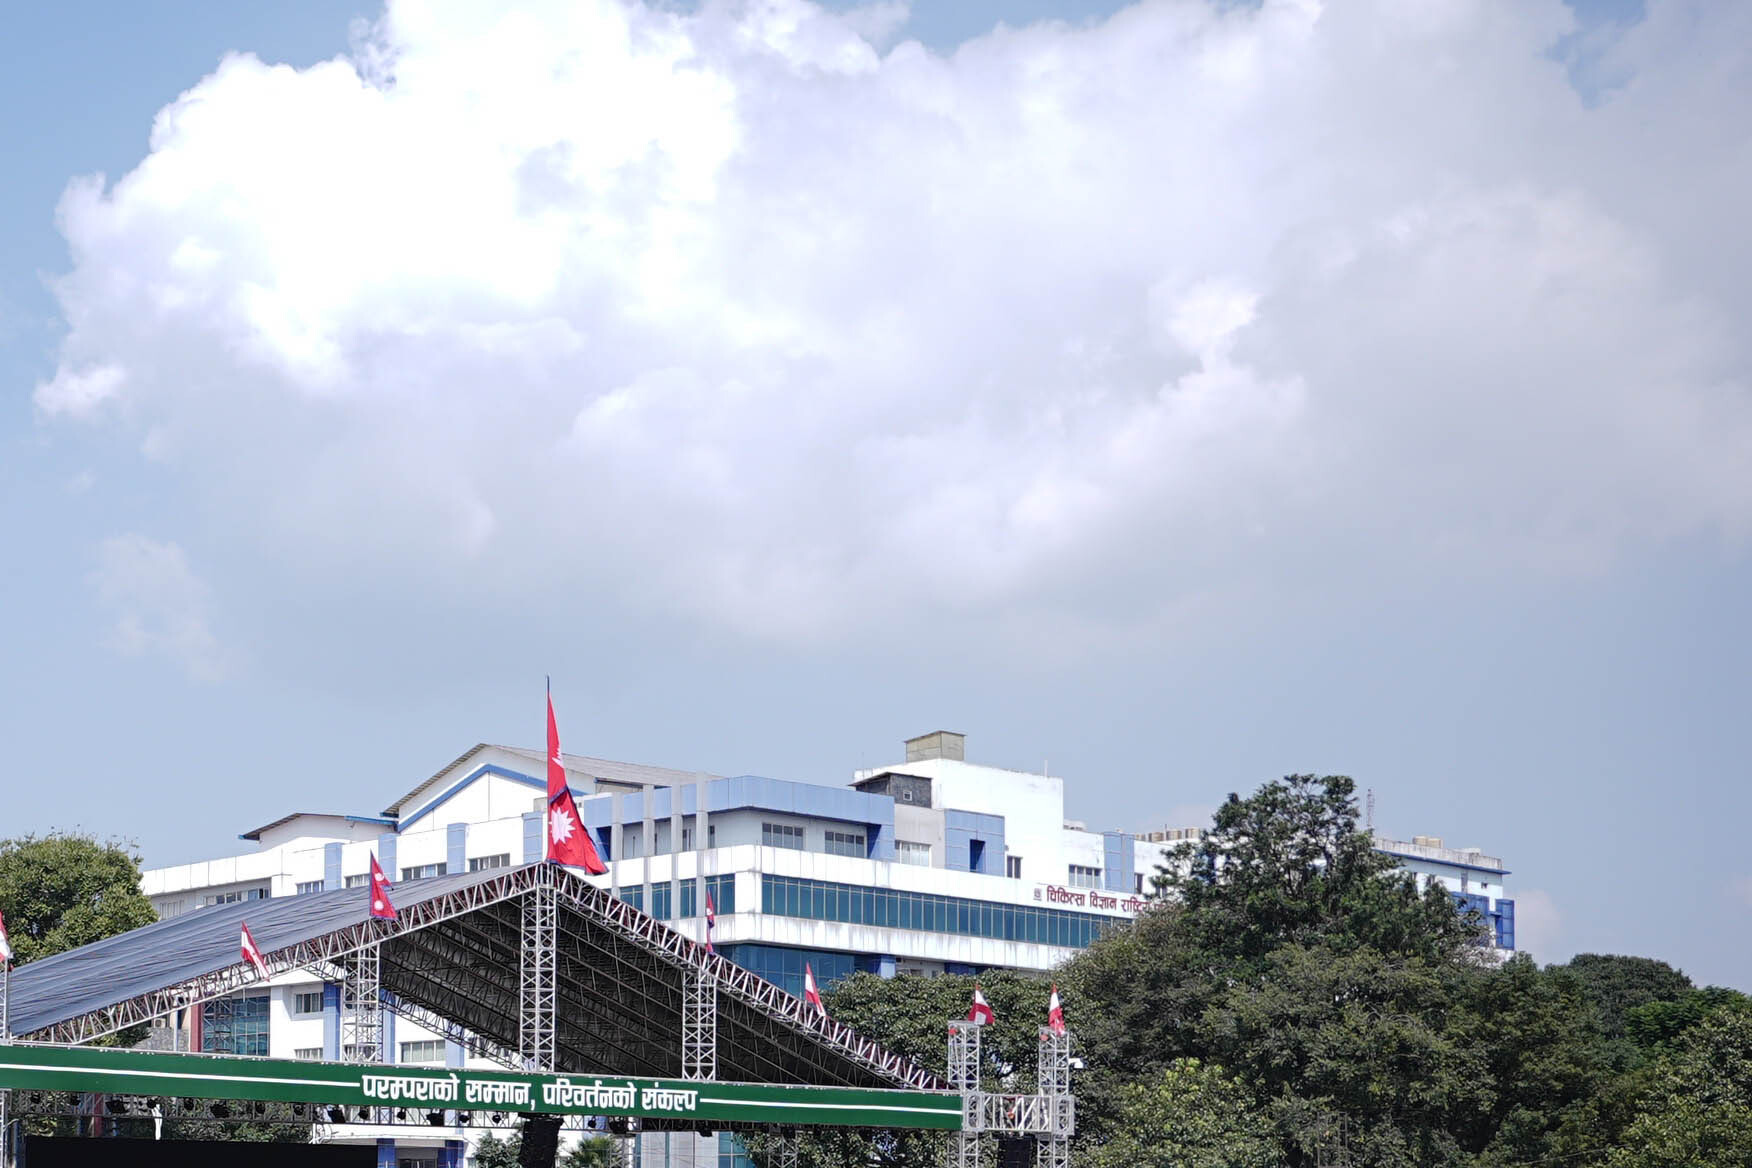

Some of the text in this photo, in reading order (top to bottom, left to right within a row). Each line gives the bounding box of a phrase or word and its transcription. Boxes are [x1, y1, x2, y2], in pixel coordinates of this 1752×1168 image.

[1047, 885, 1086, 907] चिकित्सा
[1089, 891, 1117, 911] विज्ञान
[361, 1073, 698, 1111] परम्पराको सम्मान, परिवर्तनको संकल्प
